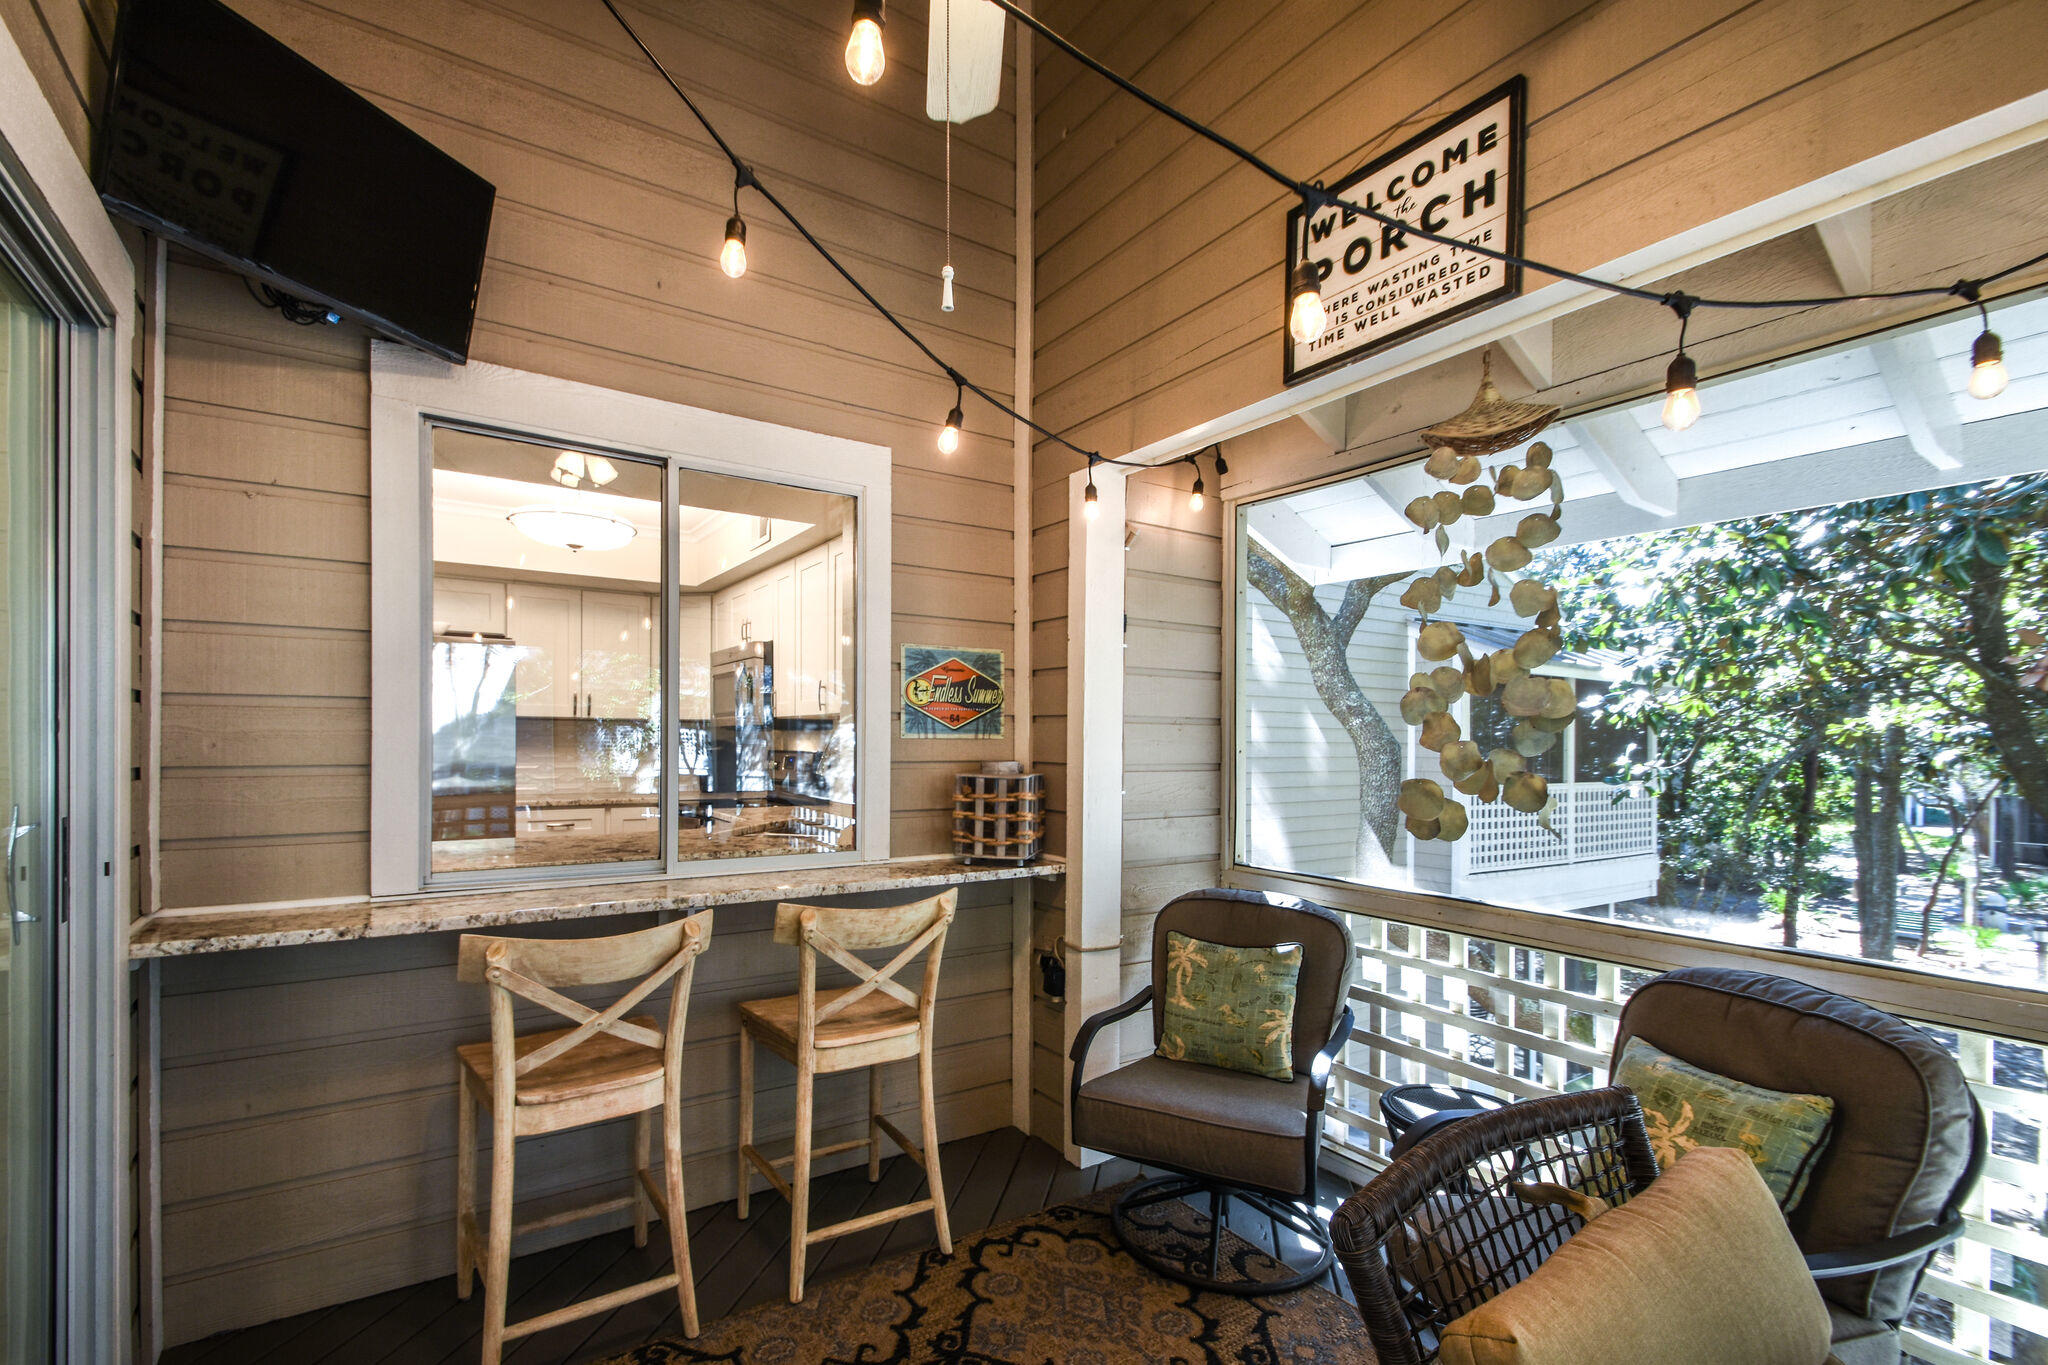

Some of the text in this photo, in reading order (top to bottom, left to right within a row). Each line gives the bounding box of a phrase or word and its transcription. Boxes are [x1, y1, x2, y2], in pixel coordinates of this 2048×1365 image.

[1311, 122, 1498, 244] WELCOME
[1393, 196, 1418, 219] the
[1322, 229, 1493, 315] HERE WASTING TME
[1336, 261, 1460, 326] IS CONSIDERED
[1308, 265, 1491, 352] TIME WELL WASTED
[927, 674, 1004, 706] Endless Summer
[949, 713, 961, 724] 64
